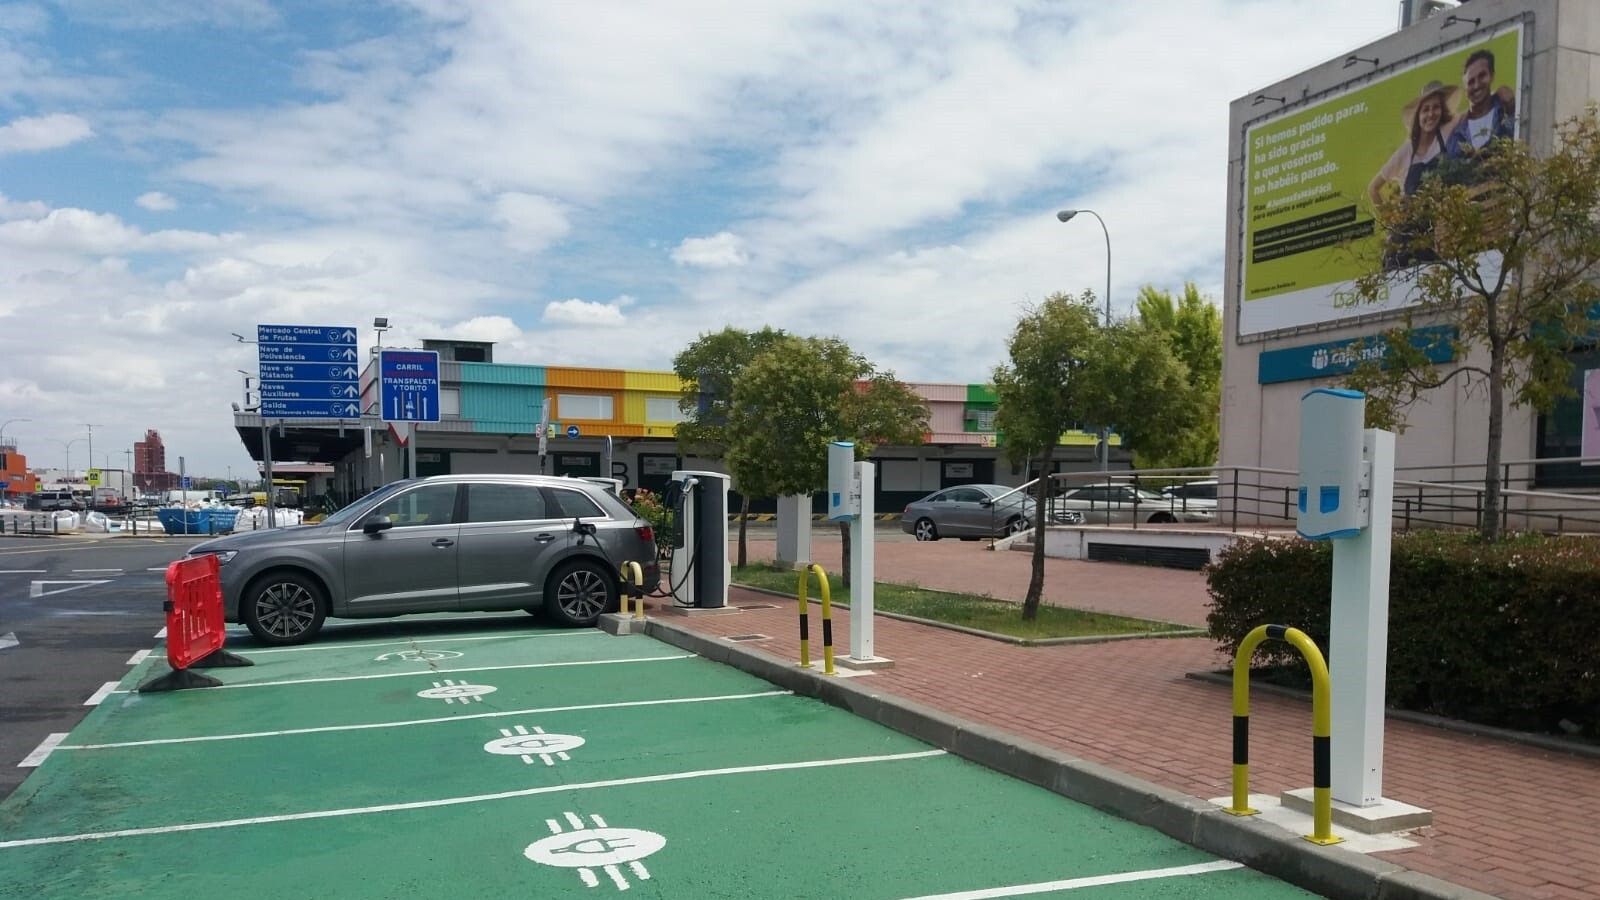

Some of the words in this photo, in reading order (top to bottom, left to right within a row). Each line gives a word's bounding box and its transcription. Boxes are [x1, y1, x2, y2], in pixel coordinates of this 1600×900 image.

[1255, 136, 1264, 149] Si
[1266, 127, 1297, 144] hemos
[1299, 112, 1334, 136] podido
[1336, 102, 1368, 123] parar,
[1254, 153, 1266, 164] ha
[1268, 145, 1288, 160] sido
[1290, 133, 1326, 155] gracias
[1254, 171, 1261, 180] a
[1263, 164, 1280, 179] que
[1281, 150, 1324, 170] vosotros
[1254, 184, 1266, 195] no
[1268, 172, 1299, 191] habéis
[1301, 161, 1339, 184] parado.
[1332, 345, 1386, 366] cajmar
[384, 377, 437, 385] TRANSPALETA
[612, 462, 628, 487] B
